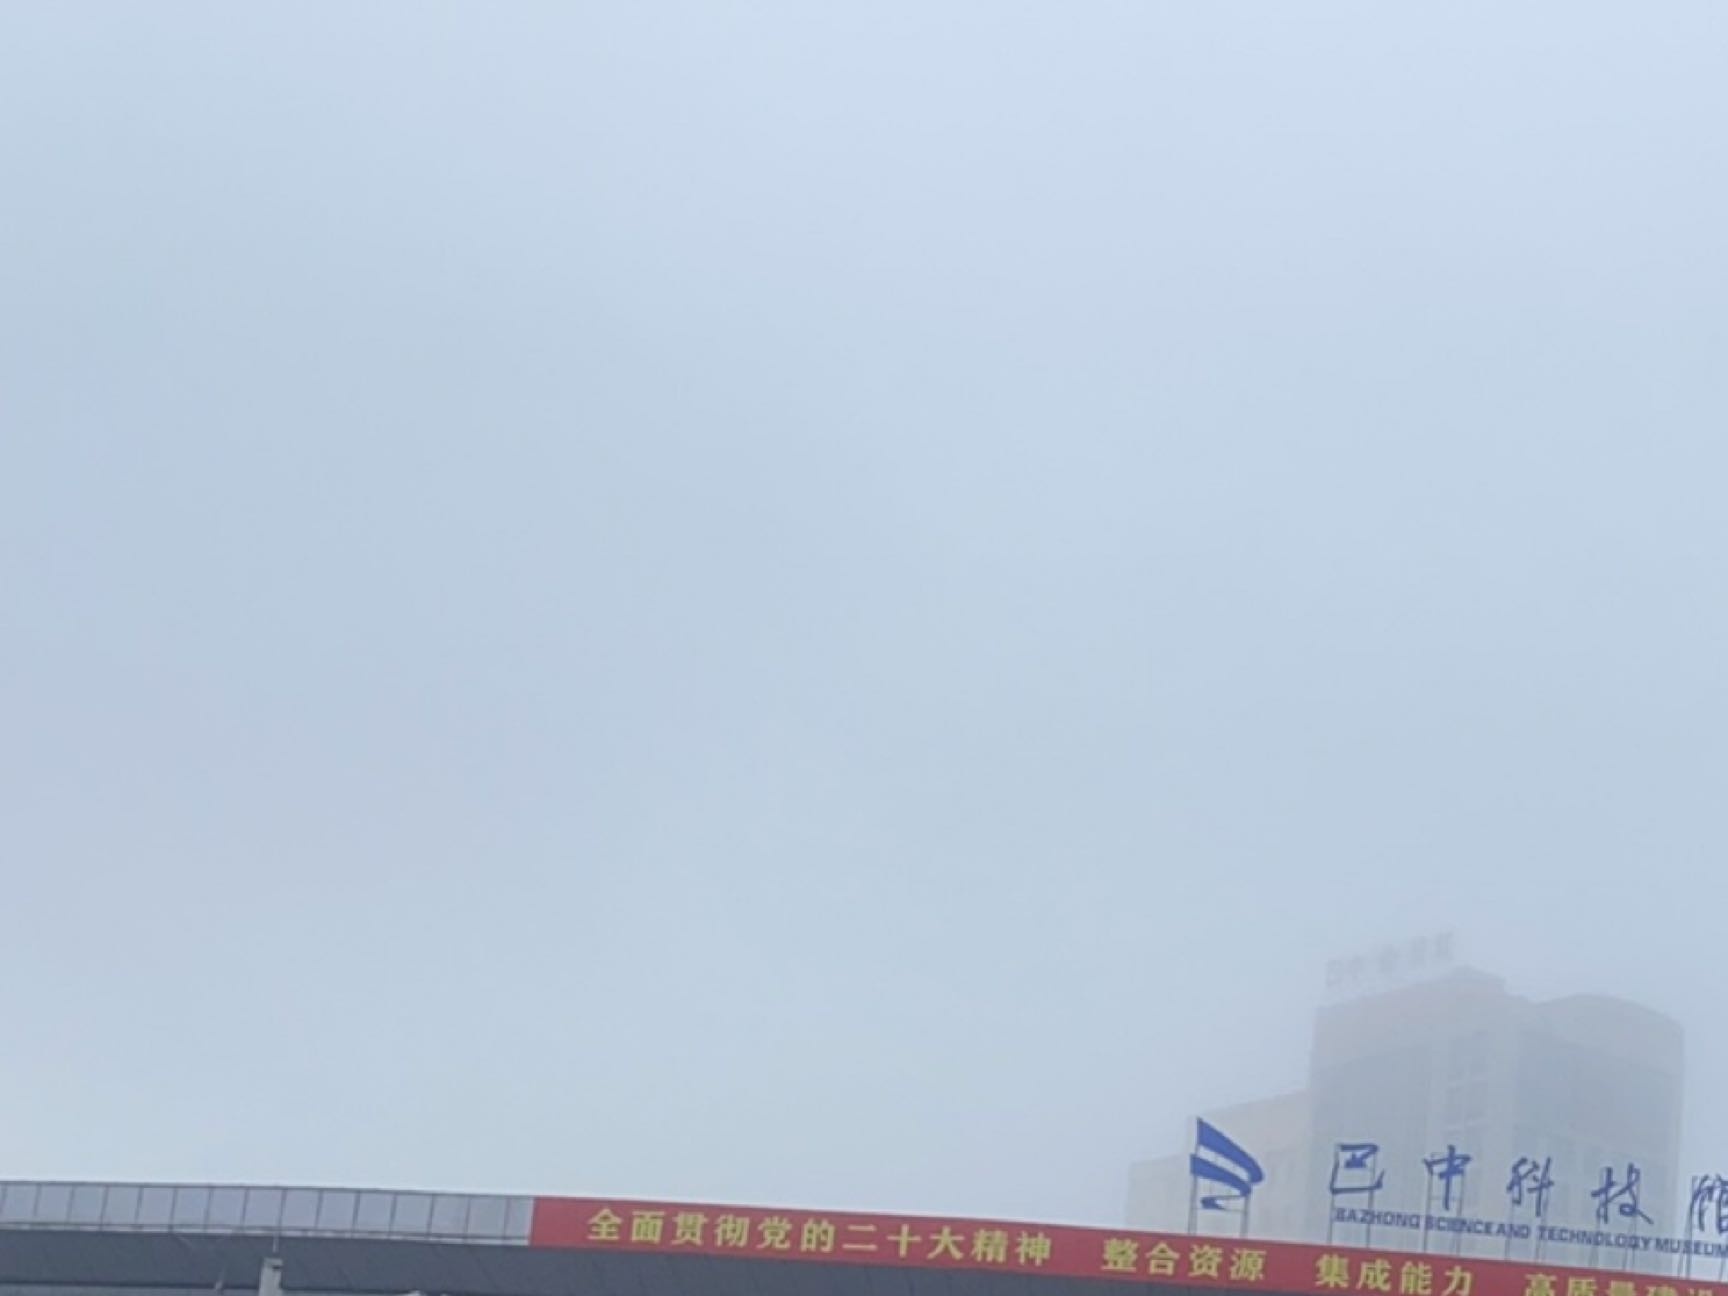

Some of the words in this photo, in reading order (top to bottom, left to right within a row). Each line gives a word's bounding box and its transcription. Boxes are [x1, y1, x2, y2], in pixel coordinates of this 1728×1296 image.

[587, 1207, 1052, 1267] 全面贯彻党的二十大精神
[1101, 1238, 1267, 1281] 整合资源
[1496, 1221, 1532, 1240] AND
